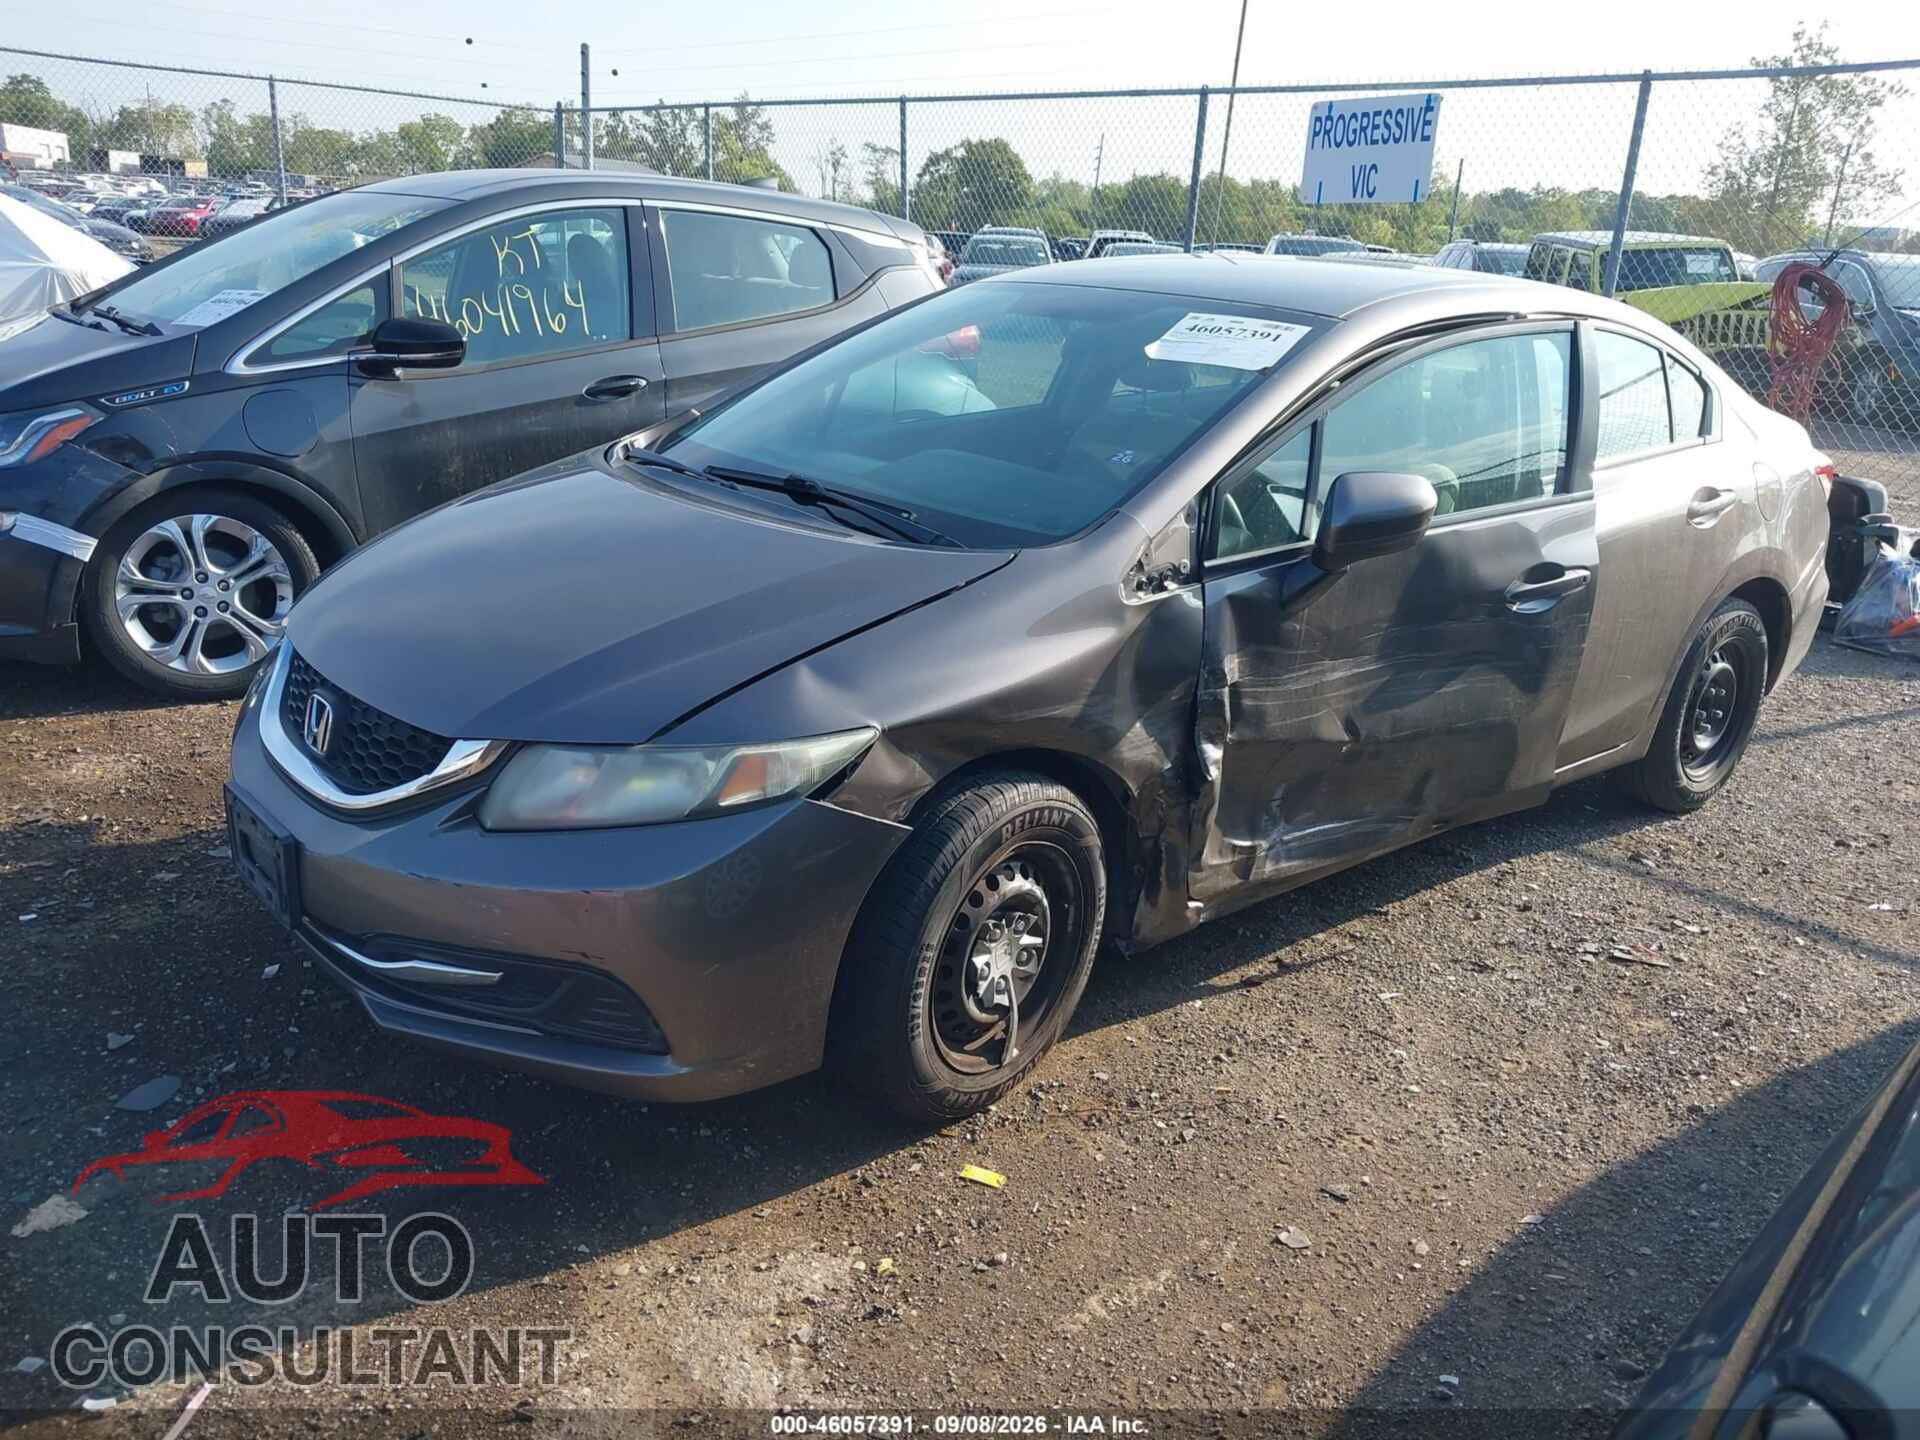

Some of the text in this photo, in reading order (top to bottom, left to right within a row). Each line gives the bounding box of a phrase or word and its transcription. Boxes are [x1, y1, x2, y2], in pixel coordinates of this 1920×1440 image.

[1311, 105, 1435, 150] PROGRESSIVE
[1351, 163, 1379, 199] VIC
[490, 229, 540, 277] KT
[415, 279, 590, 337] 46041964
[1185, 323, 1282, 342] 46057391
[115, 383, 185, 404] BOLT EV
[1001, 808, 1074, 843] RELIANT
